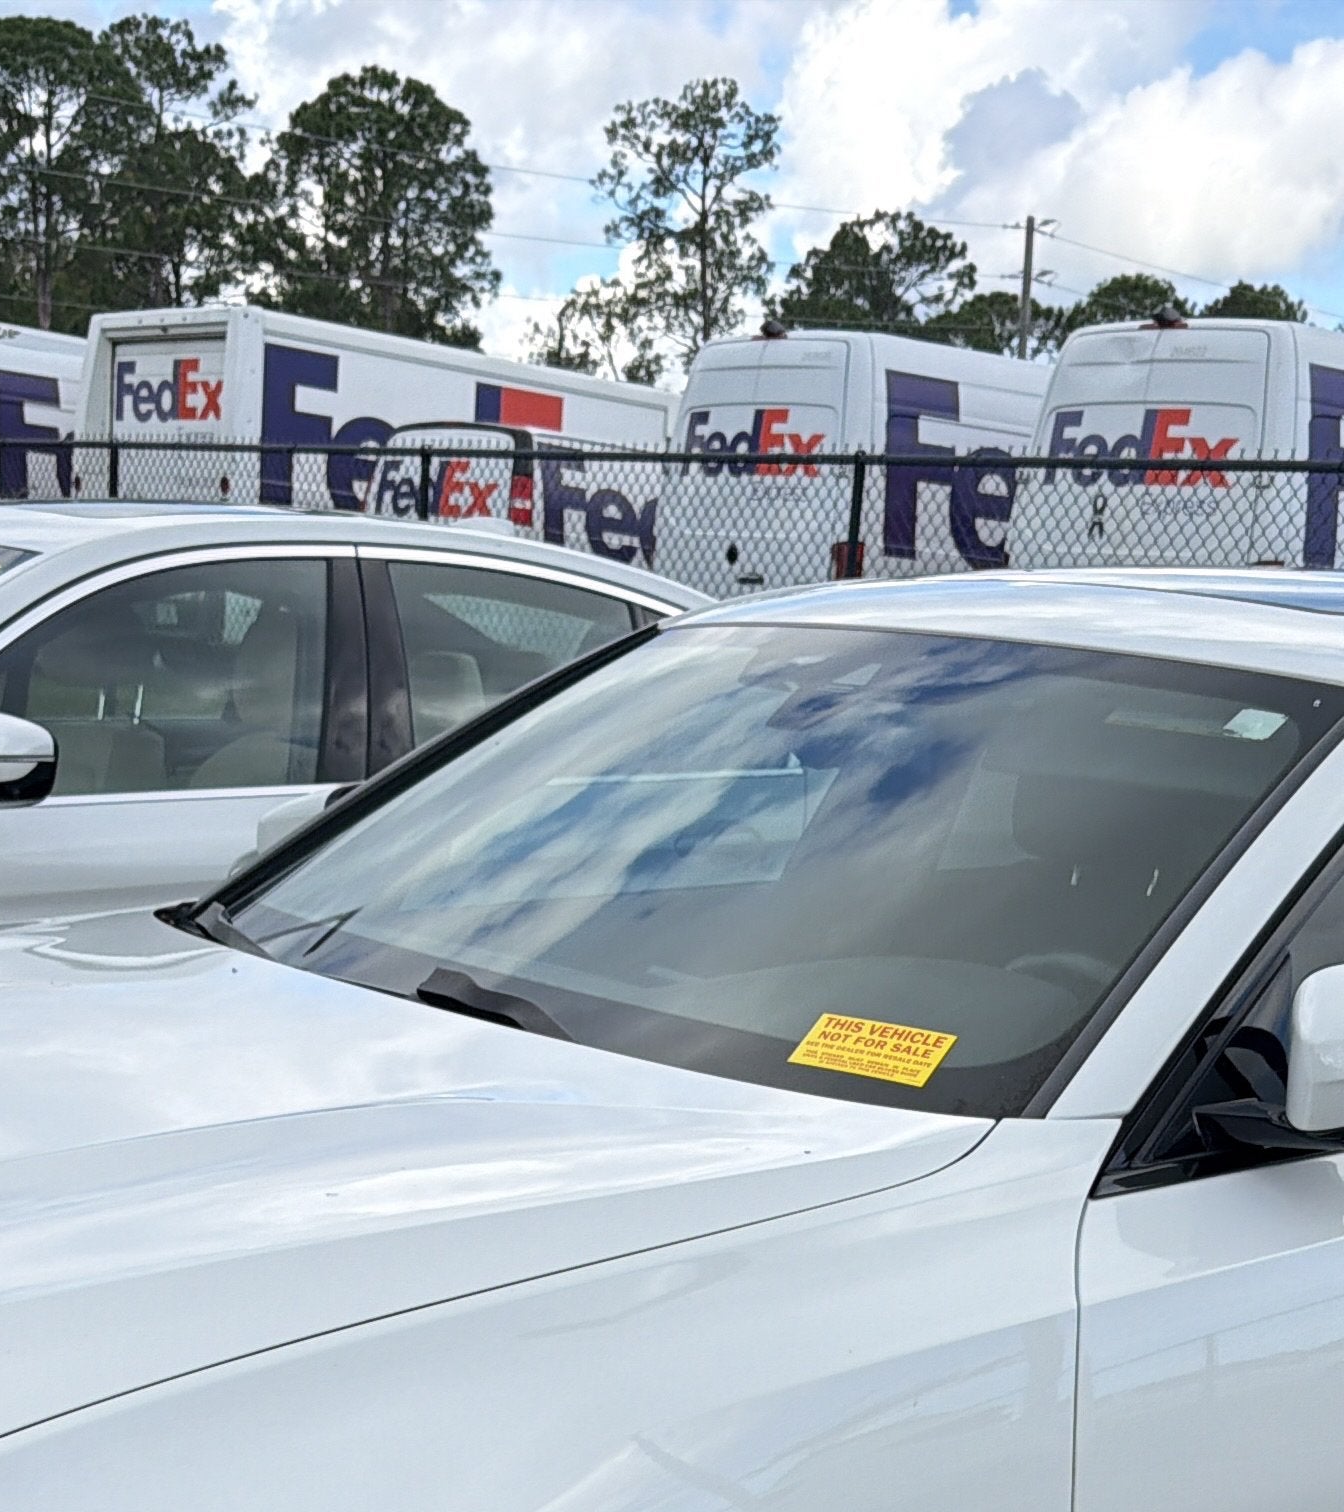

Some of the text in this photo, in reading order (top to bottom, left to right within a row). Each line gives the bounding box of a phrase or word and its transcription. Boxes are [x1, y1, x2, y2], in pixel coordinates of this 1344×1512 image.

[115, 359, 223, 423] FedEx
[685, 408, 824, 476] FedEx
[1043, 408, 1240, 488] FedEx
[818, 1030, 934, 1059] NOT FOR SALE
[824, 1017, 947, 1049] THIS VEHICLE
